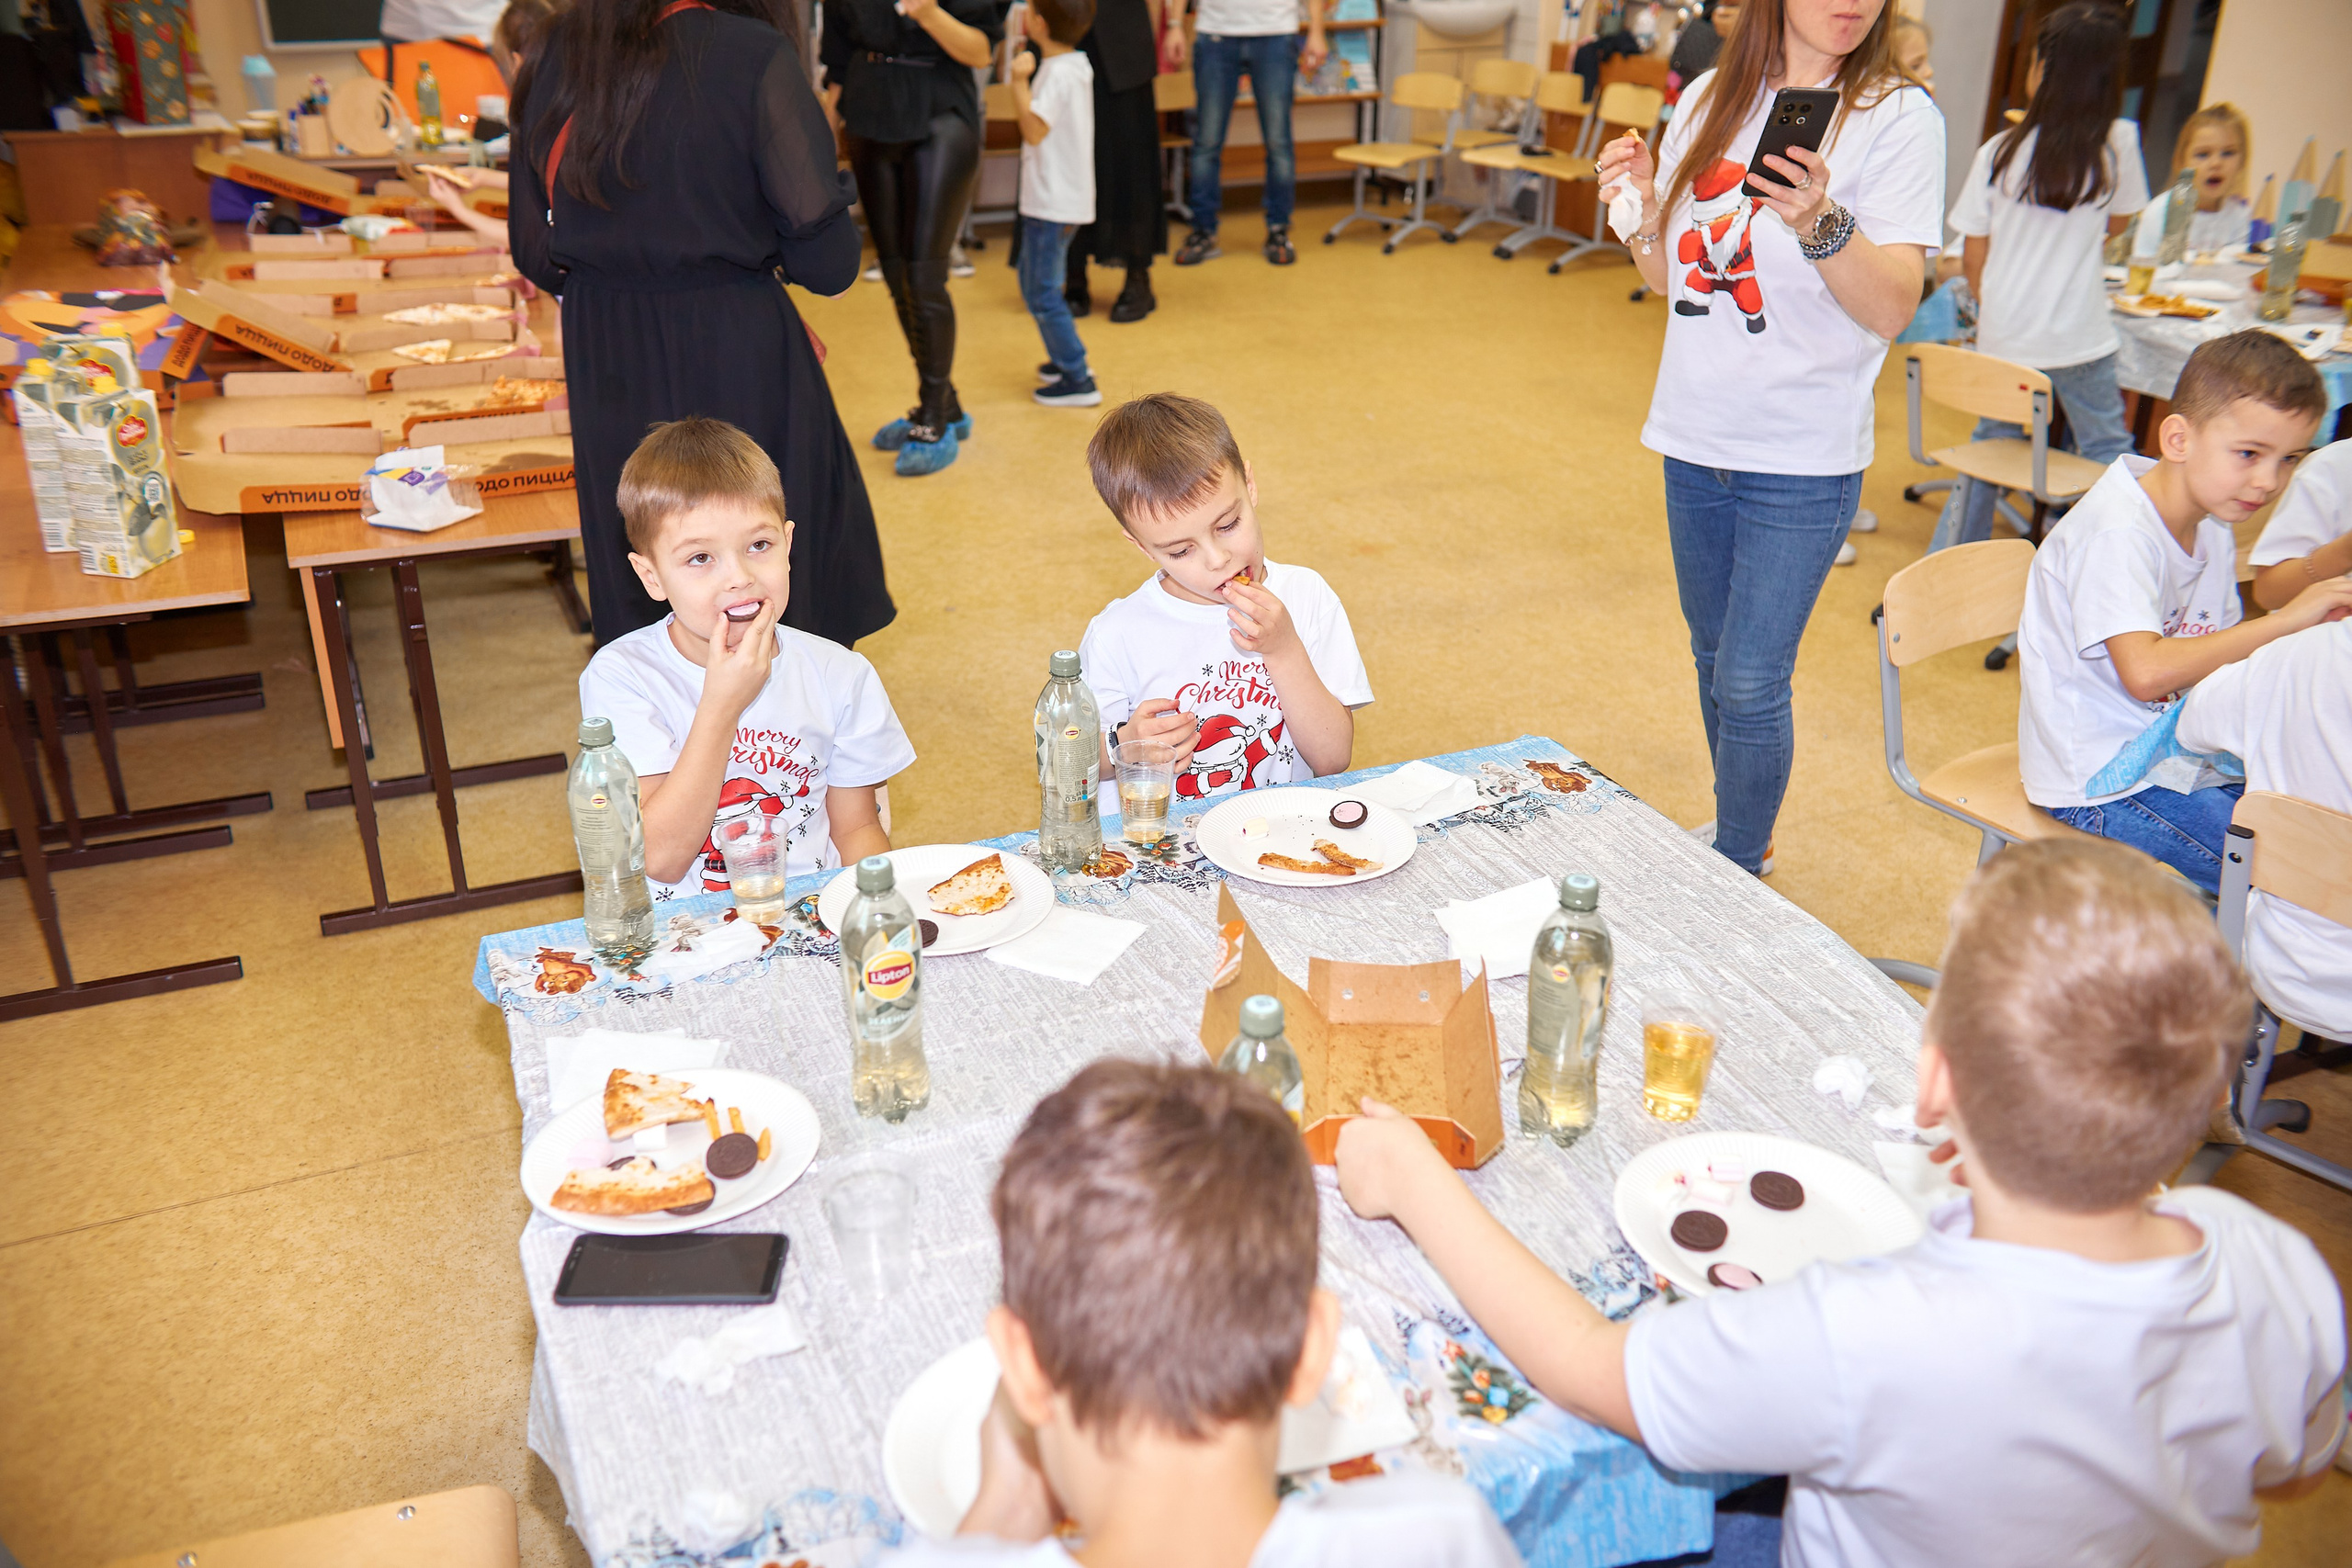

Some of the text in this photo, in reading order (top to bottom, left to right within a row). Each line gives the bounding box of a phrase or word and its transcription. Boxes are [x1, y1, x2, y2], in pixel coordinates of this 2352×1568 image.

[235, 324, 335, 372] ДОДО ПИЦЦА
[473, 470, 575, 492] ОДО ПИЦЦА
[262, 488, 372, 504] ОДО ПИЦЦА
[1219, 660, 1273, 686] Merr
[1175, 677, 1283, 714] Christm
[728, 745, 820, 786] ristmas
[870, 965, 910, 984] Lipton
